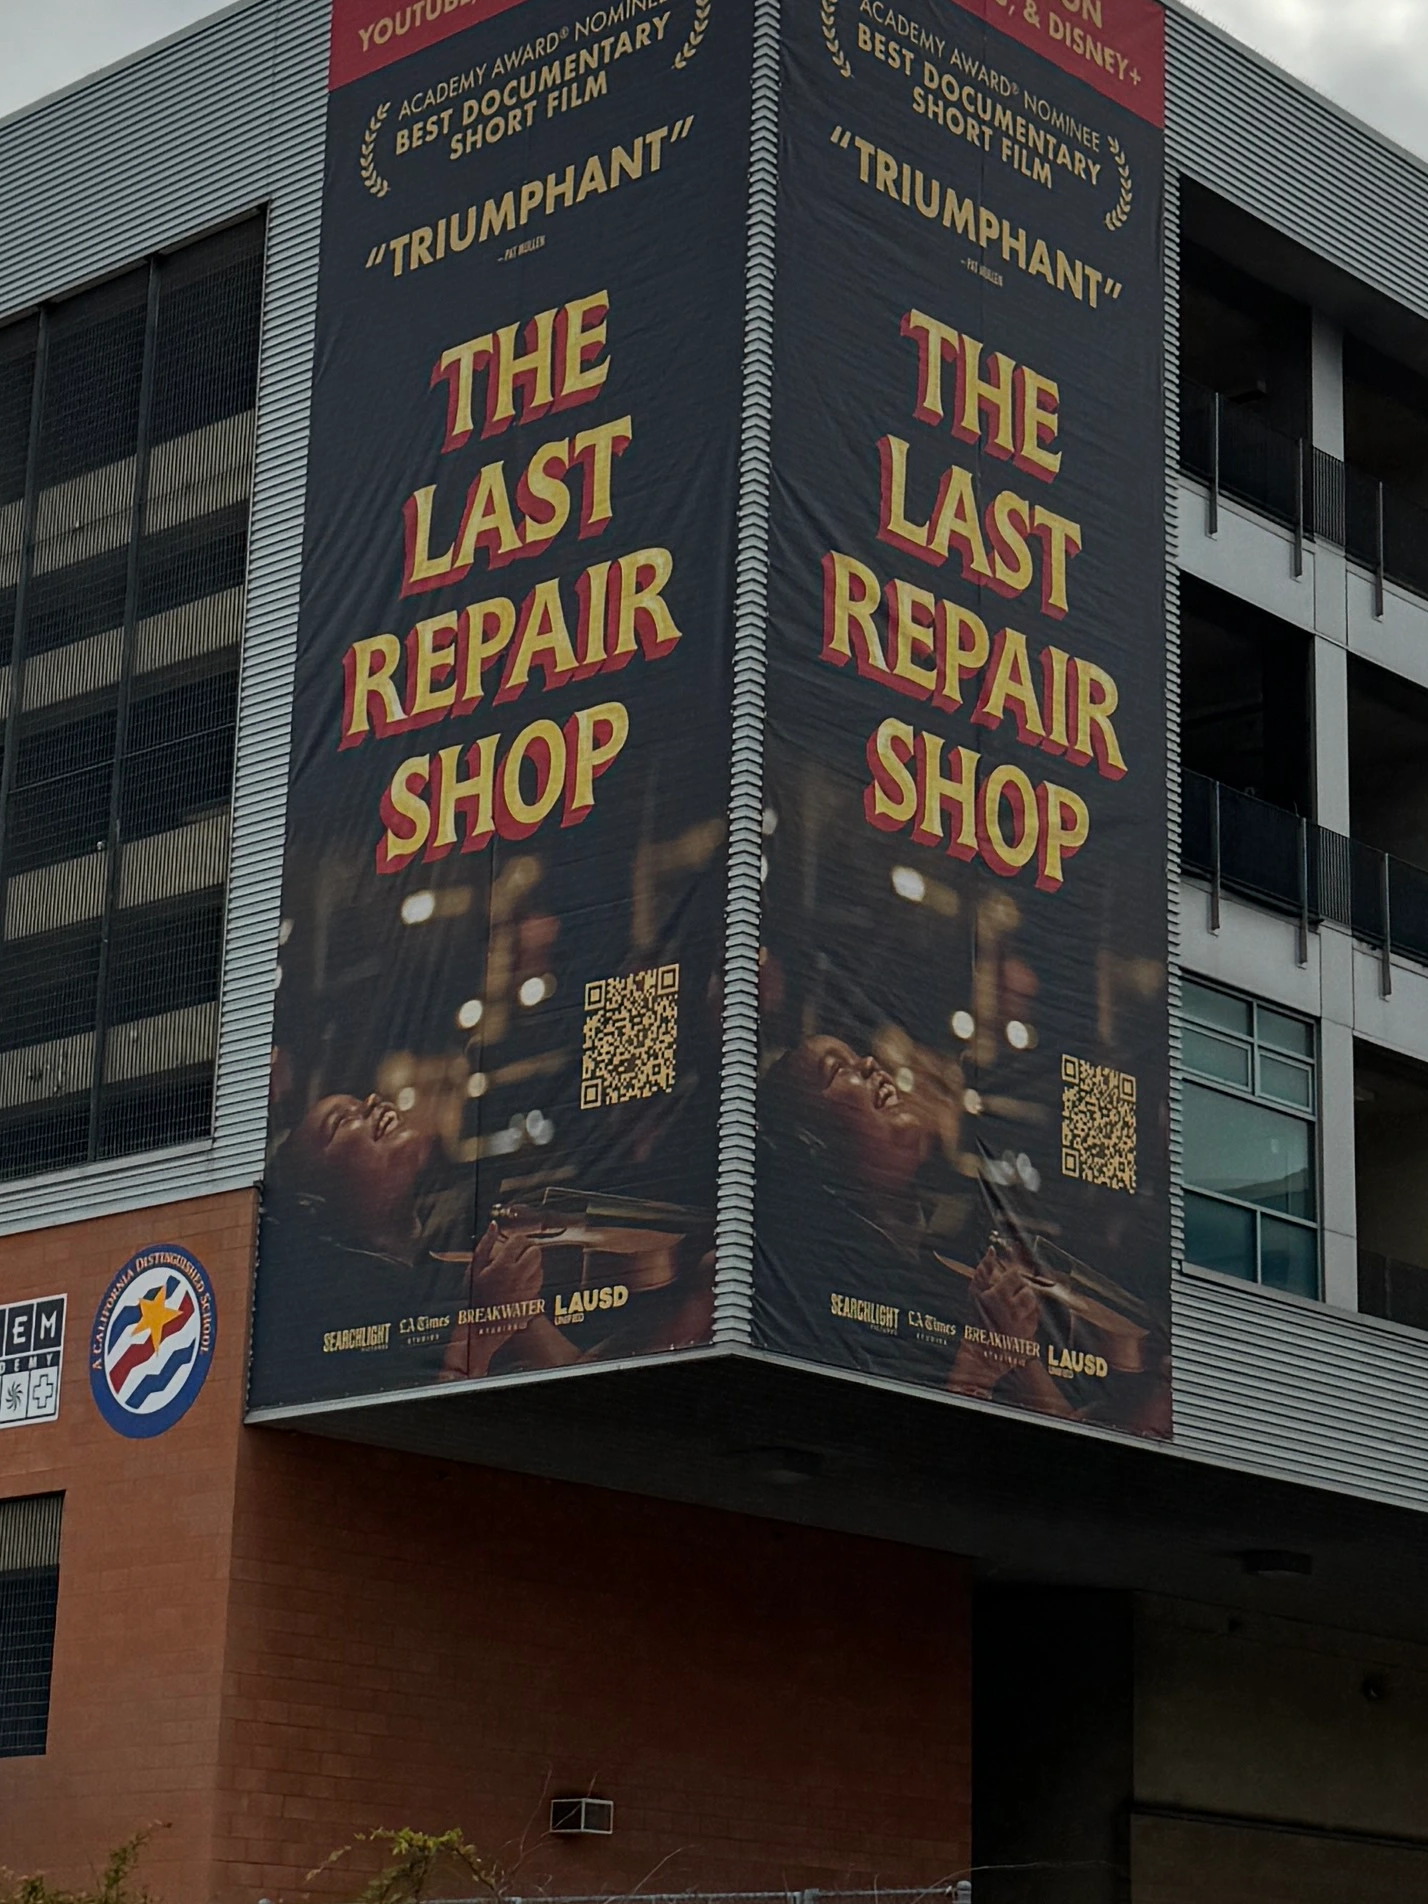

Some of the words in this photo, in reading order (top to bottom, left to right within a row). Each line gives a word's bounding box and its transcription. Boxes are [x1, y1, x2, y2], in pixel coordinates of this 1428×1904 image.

[395, 108, 454, 155] BEST
[462, 12, 672, 125] DOCUMENTARY
[398, 63, 488, 121] ACADEMY
[449, 100, 537, 161] SHORT
[547, 71, 608, 118] FILM
[858, 23, 915, 76] BEST
[924, 61, 1102, 186] DOCUMENTARY
[1022, 0, 1041, 29] &
[1049, 13, 1142, 86] DISNEY+
[912, 87, 994, 152] SHORT
[1001, 137, 1053, 190] FILM
[1024, 90, 1100, 153] NOMINEE
[431, 289, 611, 453] THE
[900, 308, 1063, 482] THE
[400, 415, 633, 598] LAST
[876, 434, 1082, 619] LAST
[338, 546, 682, 751] REPAIR
[820, 548, 1128, 780] REPAIR
[376, 700, 630, 874] SHOP
[863, 717, 1089, 892] SHOP
[93, 1269, 134, 1354] CALIFORNIA
[323, 1322, 392, 1353] SEARCHLIGHT
[417, 1313, 451, 1332] Times
[458, 1298, 545, 1326] BREAKWATER
[554, 1285, 629, 1317] LAUSD
[830, 1293, 900, 1329] SEARCHLIGHT
[924, 1314, 957, 1336] Times
[964, 1325, 1041, 1358] BREAKWATER
[1048, 1345, 1108, 1378] LAUSD
